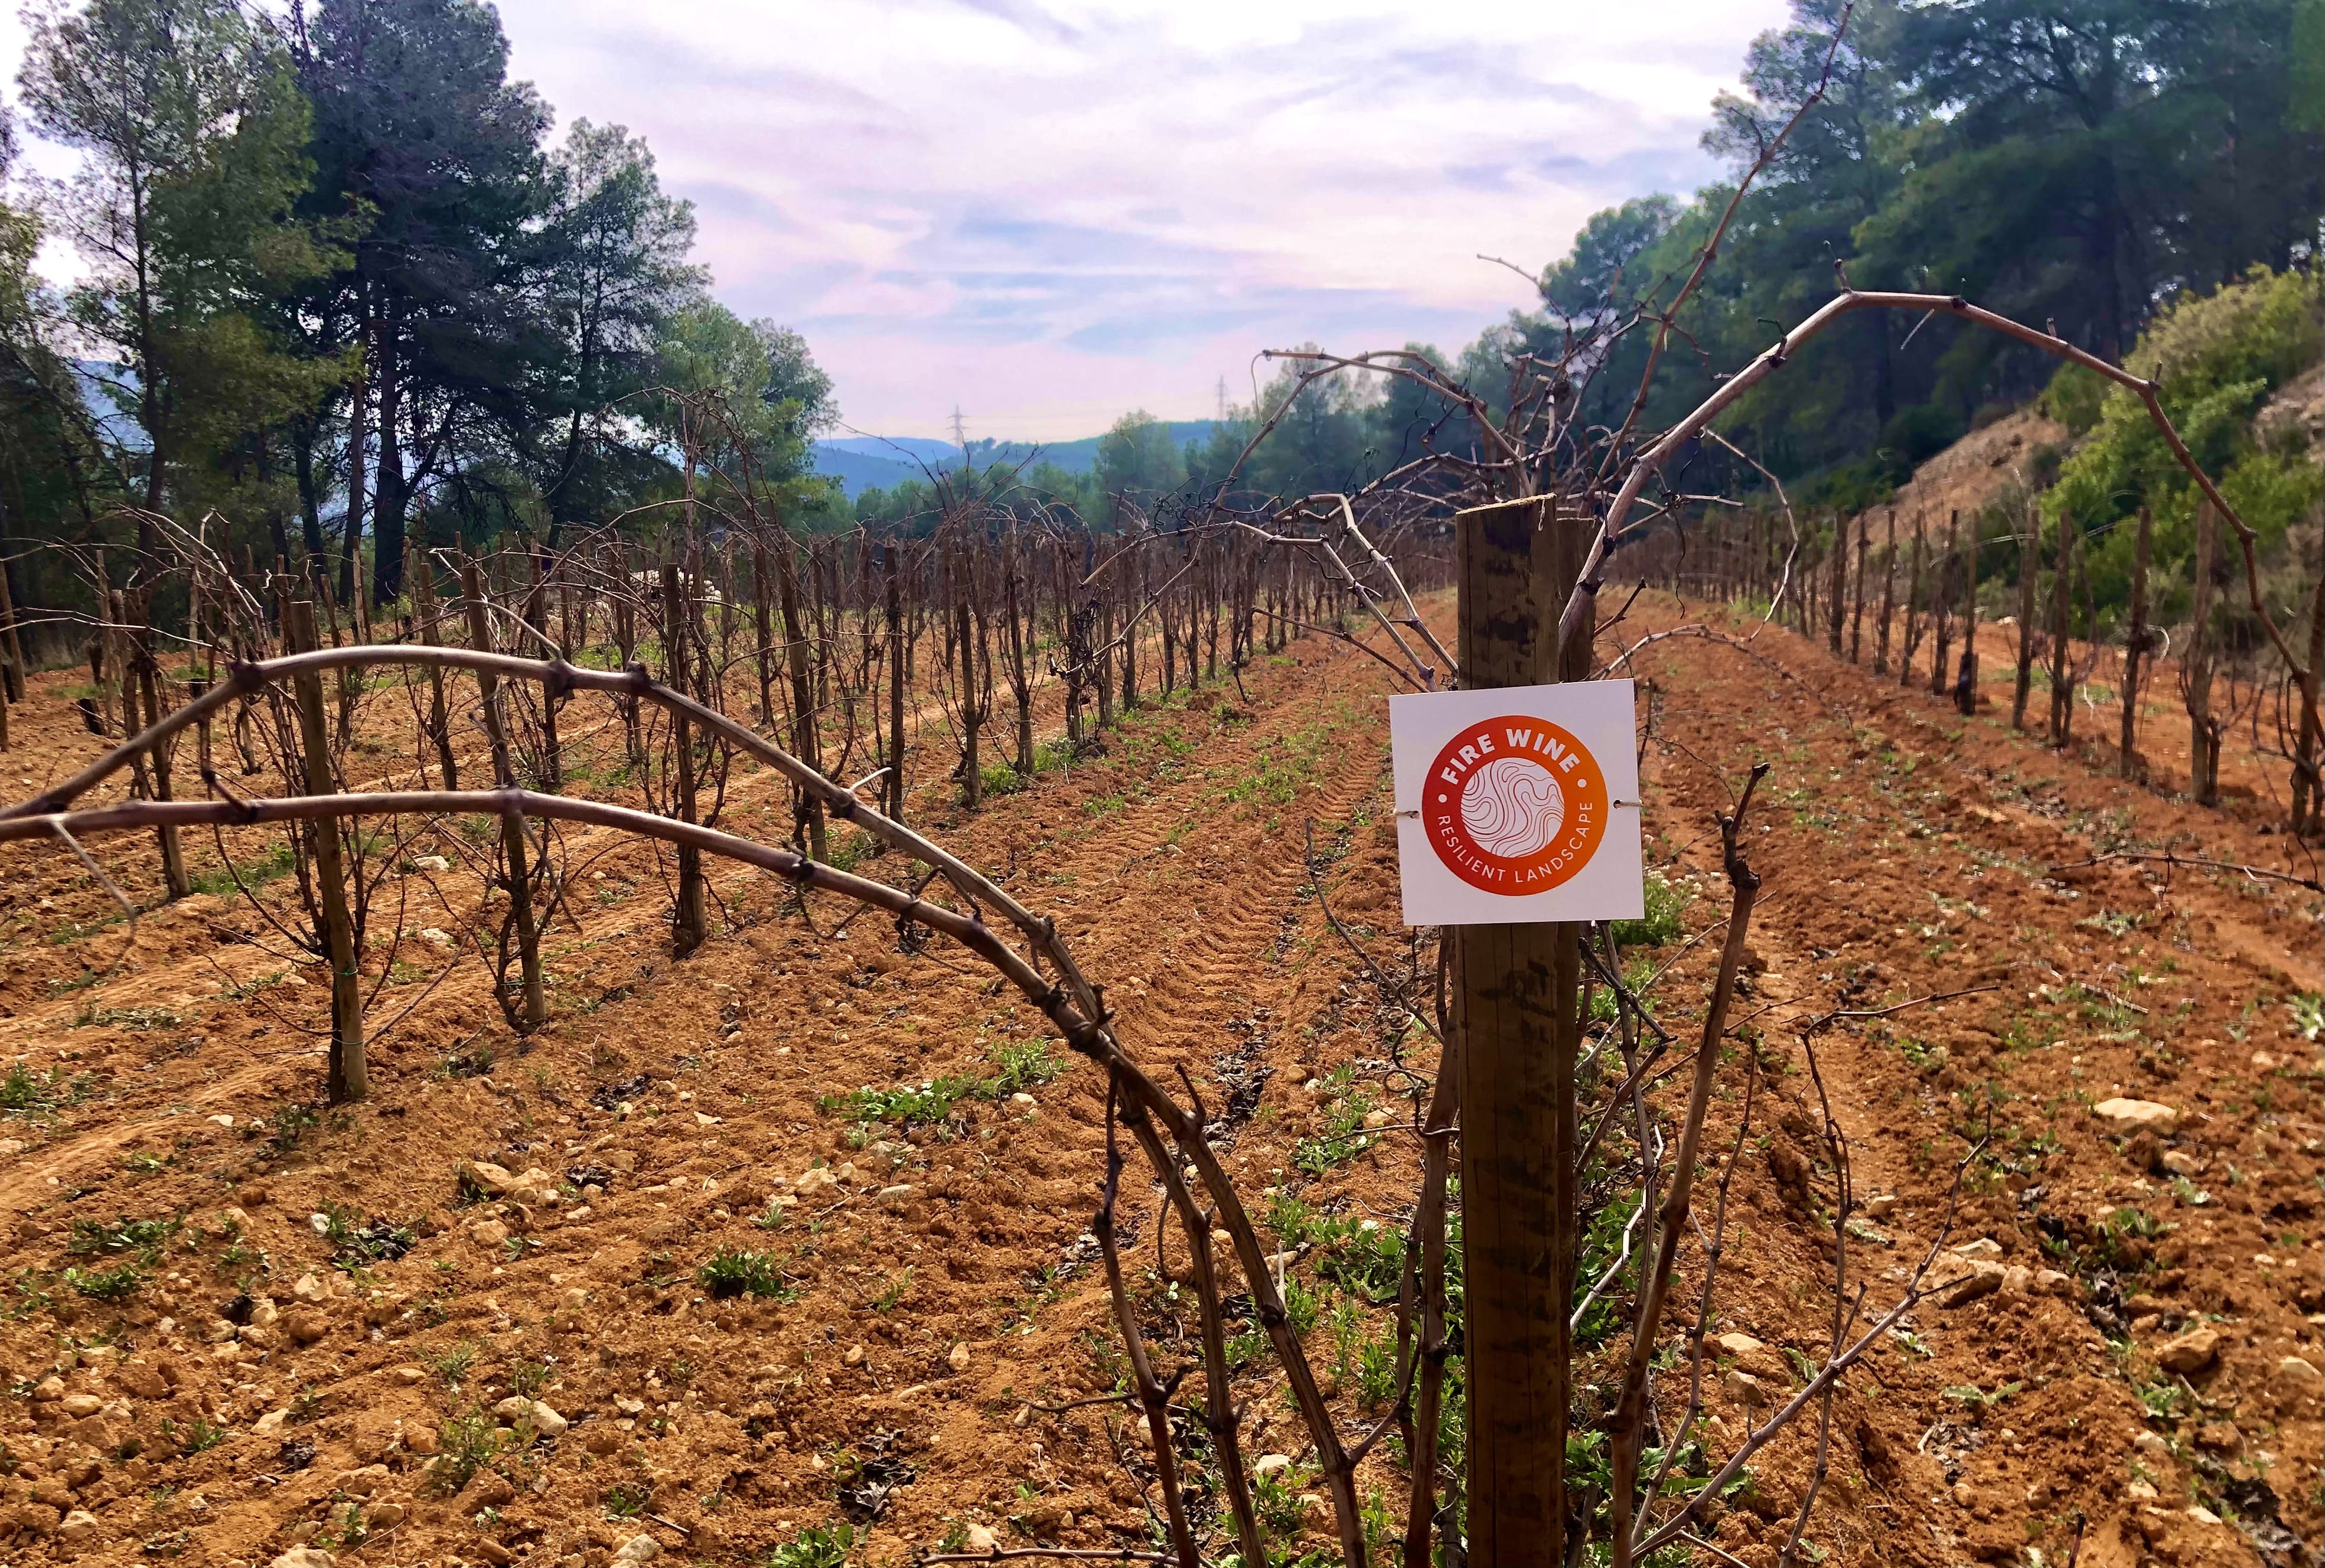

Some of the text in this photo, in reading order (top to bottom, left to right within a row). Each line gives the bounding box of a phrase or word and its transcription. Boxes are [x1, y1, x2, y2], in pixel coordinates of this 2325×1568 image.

[1440, 728, 1580, 785] FIRE WINE
[1437, 802, 1593, 882] RESILIENT LANDSCAPE
